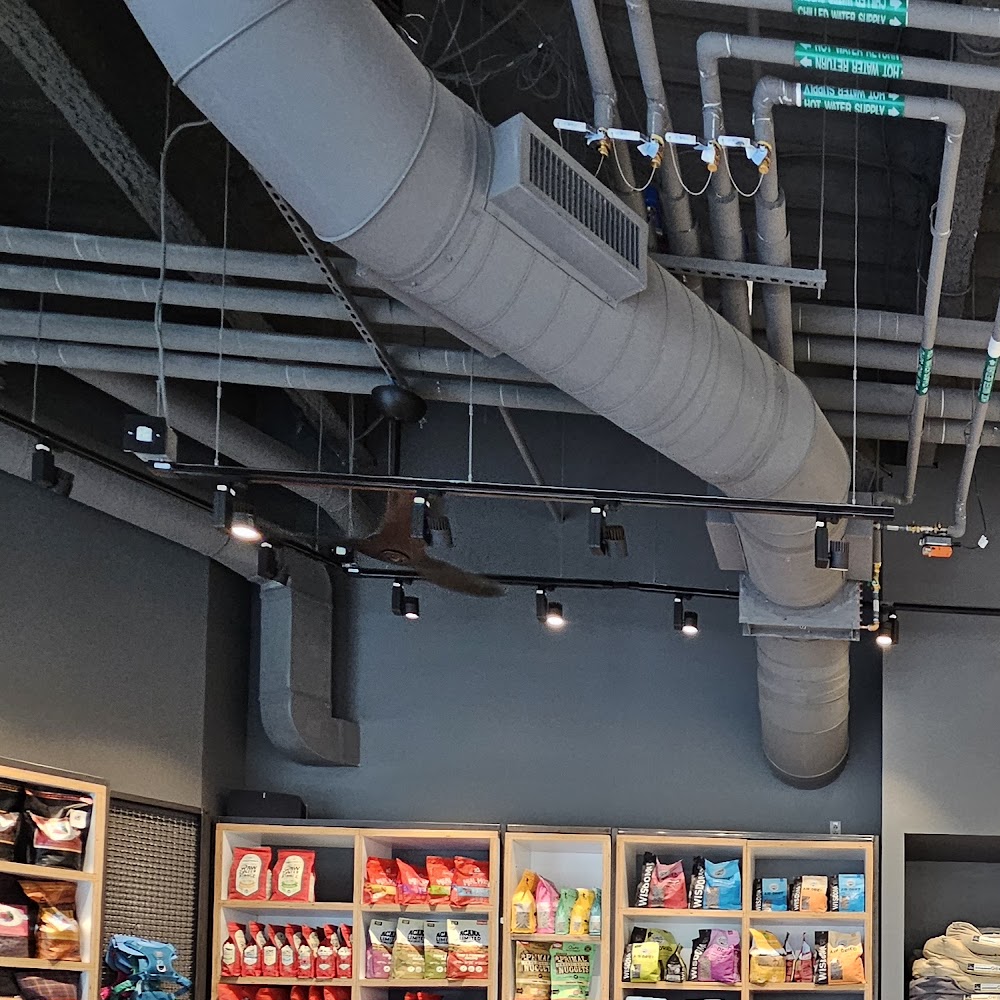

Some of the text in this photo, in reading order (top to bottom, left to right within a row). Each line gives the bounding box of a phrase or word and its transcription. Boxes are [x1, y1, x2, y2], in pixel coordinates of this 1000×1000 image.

[831, 10, 856, 21] WATER
[858, 12, 886, 25] SUPPLY
[815, 56, 900, 78] HOT WATER RETURN
[824, 101, 851, 111] WATER
[854, 103, 885, 115] SUPPLY
